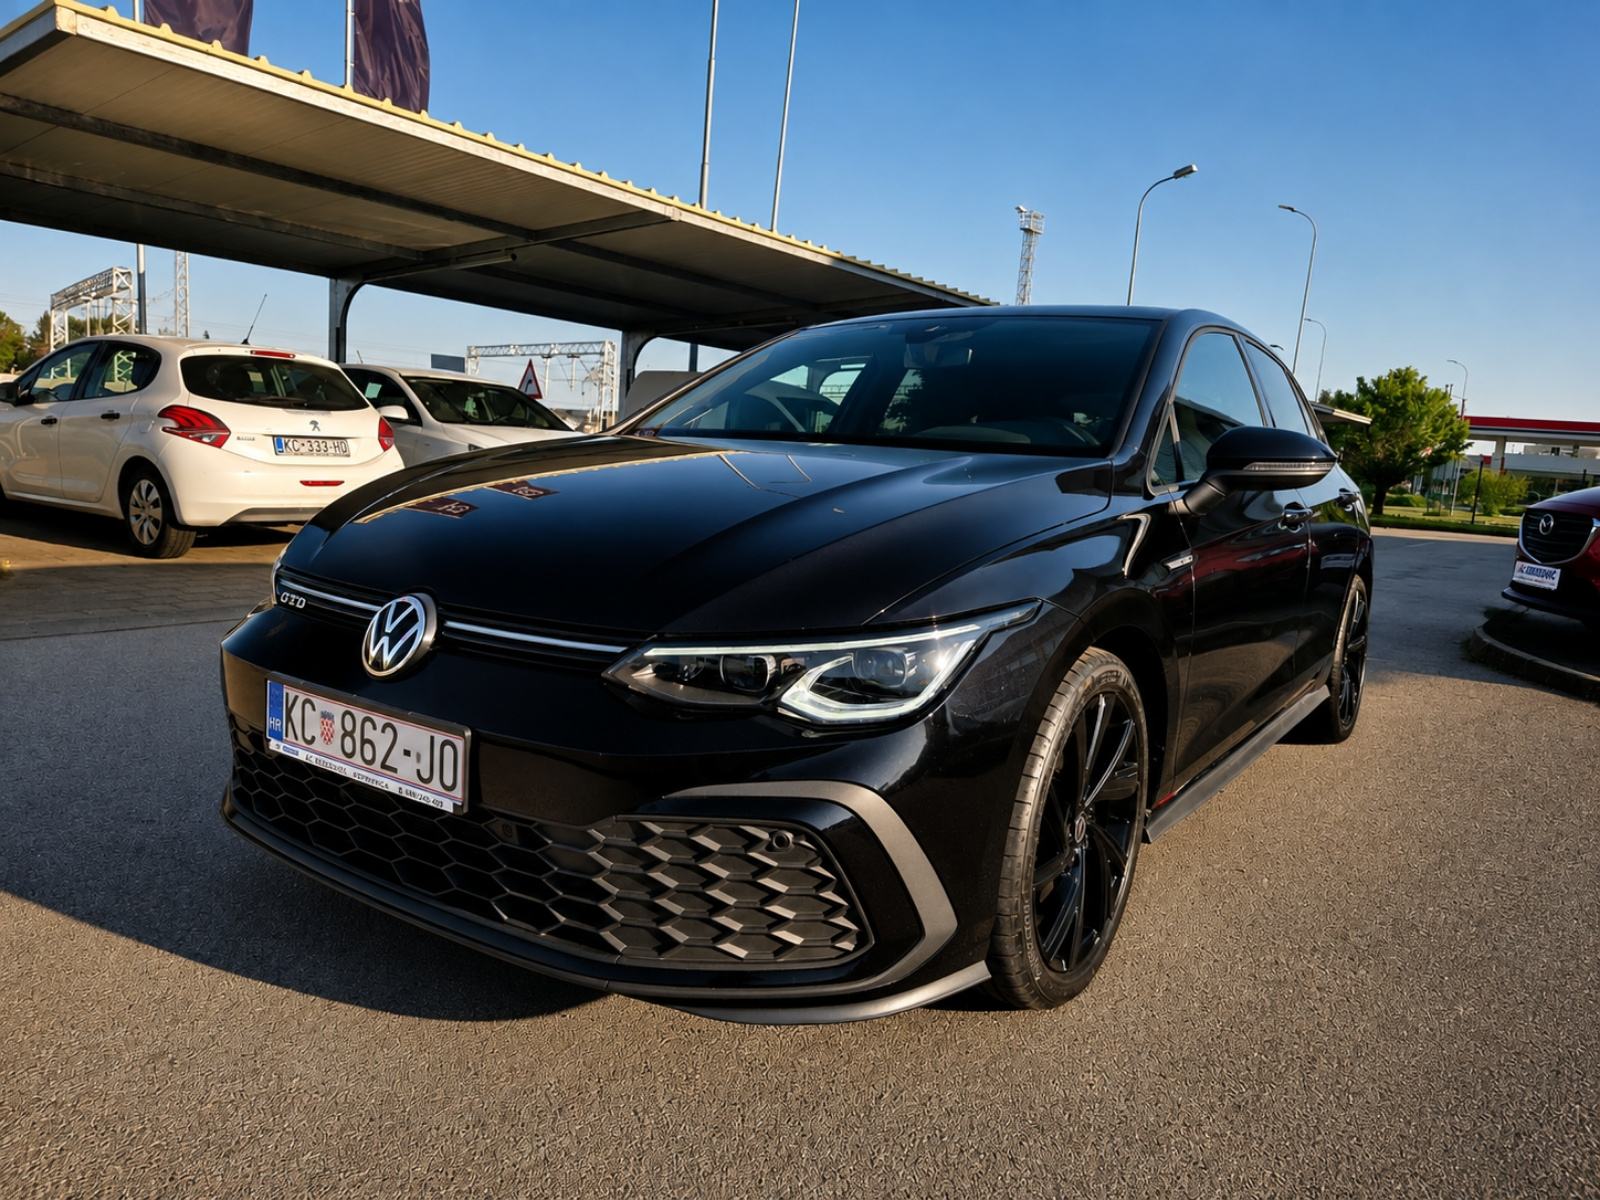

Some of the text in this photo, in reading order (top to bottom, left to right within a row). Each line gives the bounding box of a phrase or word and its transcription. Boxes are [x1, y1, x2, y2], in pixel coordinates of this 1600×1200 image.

[280, 591, 306, 609] GTD
[269, 716, 282, 732] HR
[285, 691, 316, 746] KC
